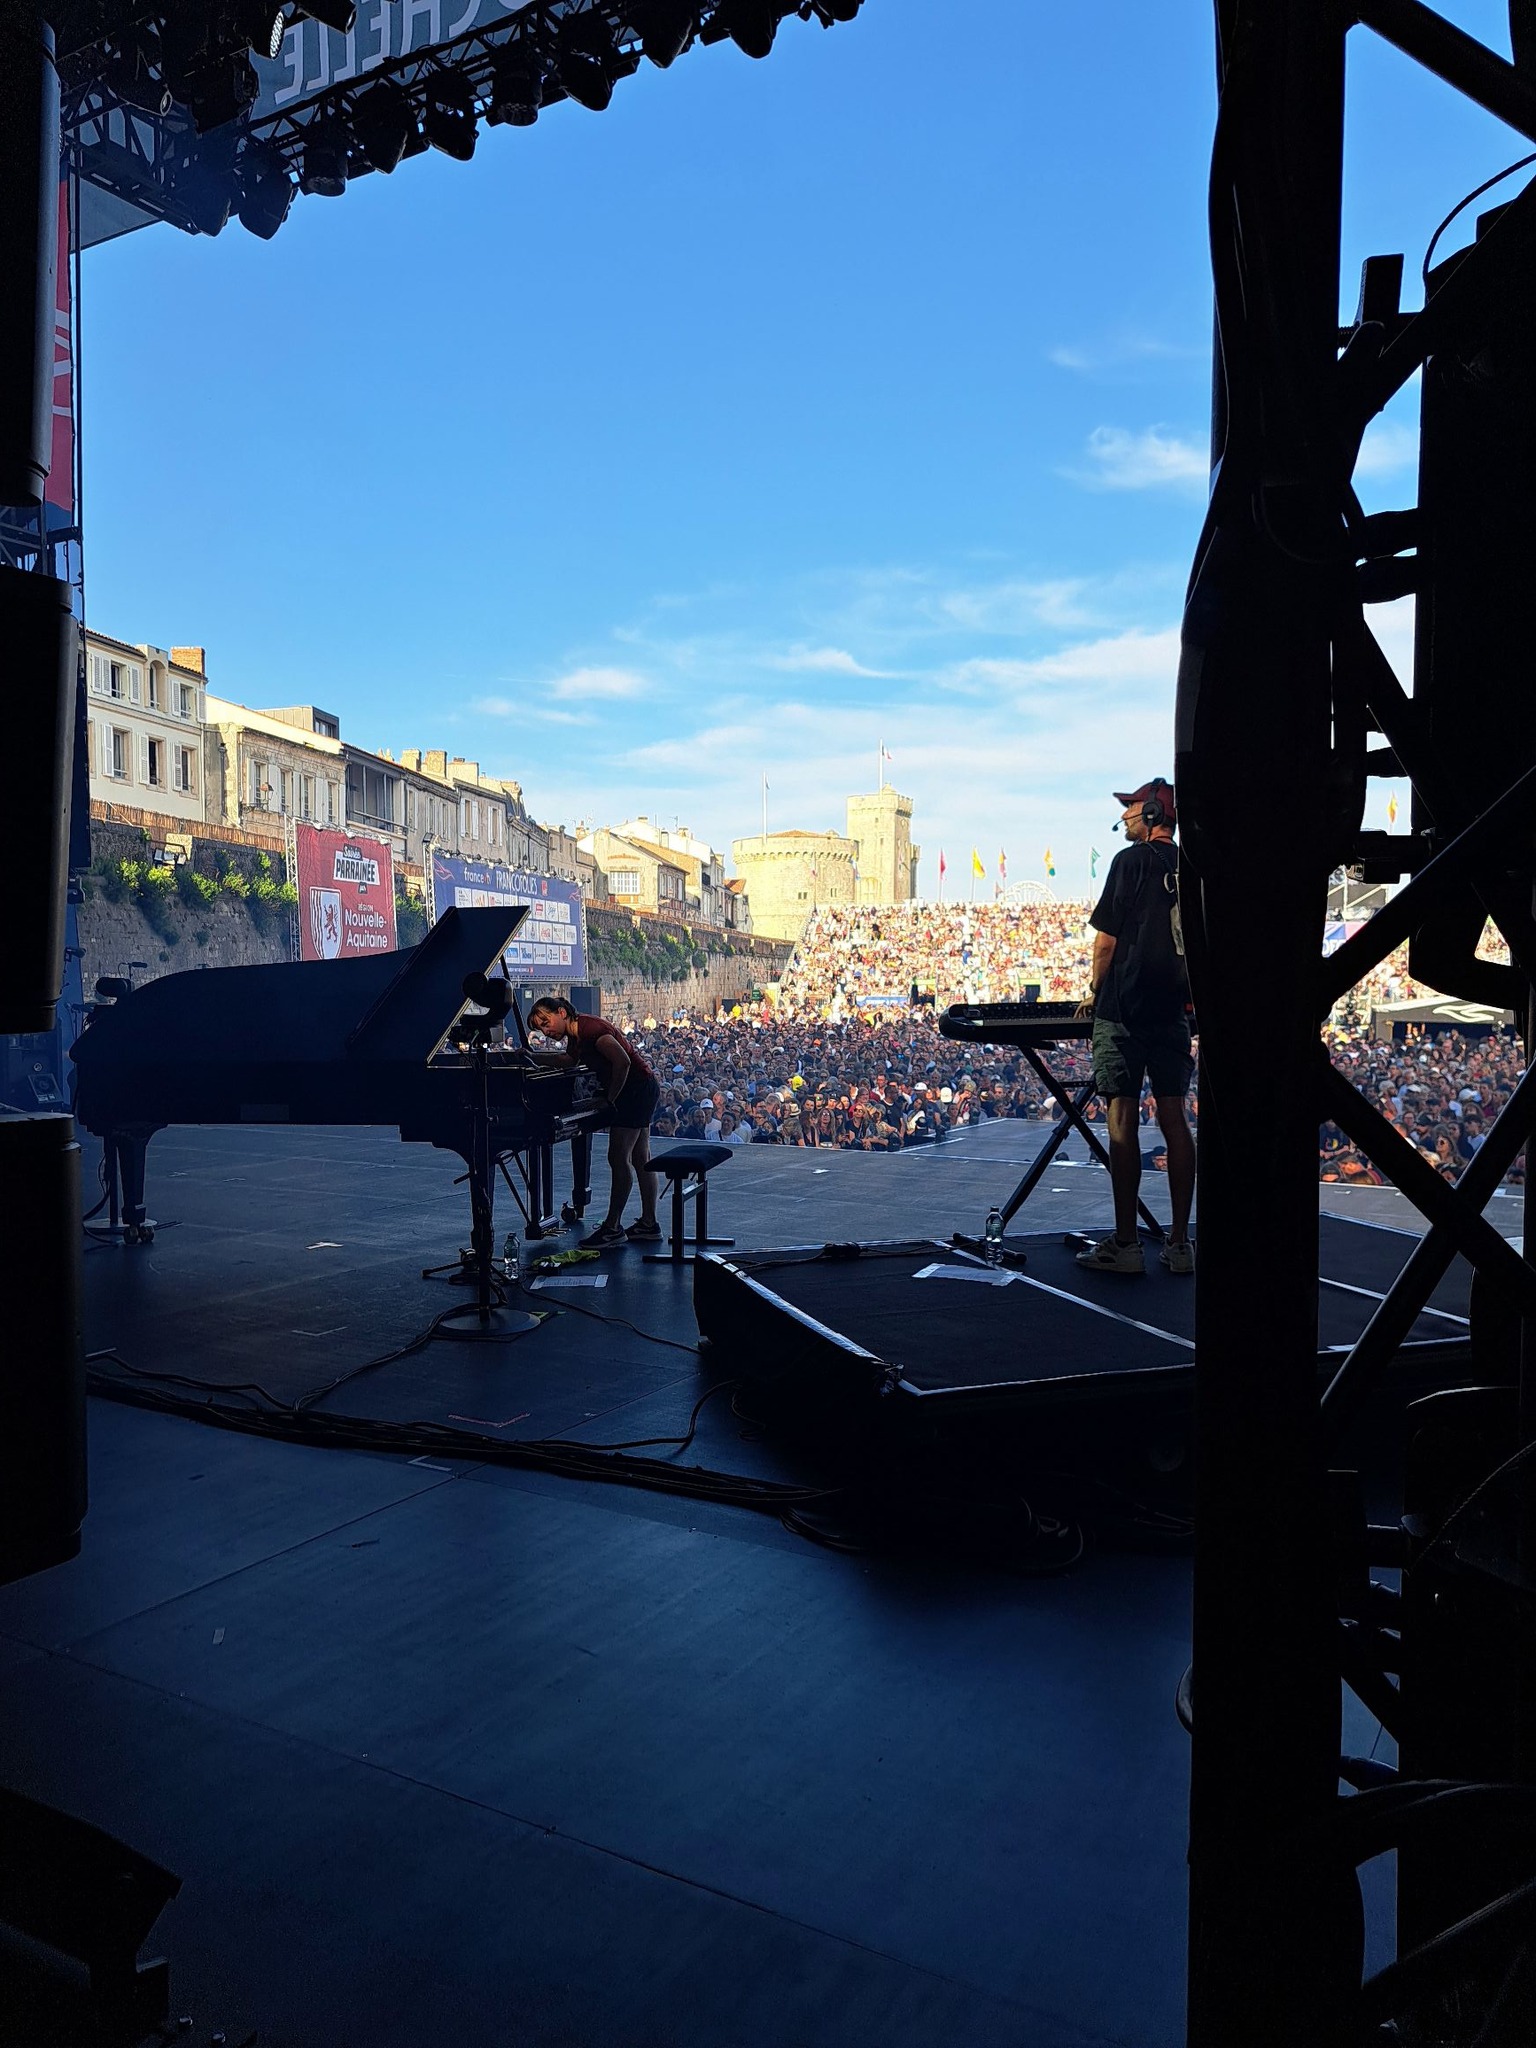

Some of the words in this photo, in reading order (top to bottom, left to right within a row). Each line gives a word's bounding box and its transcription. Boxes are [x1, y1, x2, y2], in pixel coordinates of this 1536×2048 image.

[335, 858, 375, 882] PARRAINÉE
[496, 870, 538, 895] FRANCOFOLIES
[345, 908, 387, 928] Nouvelle-
[346, 929, 388, 953] Aquitaine
